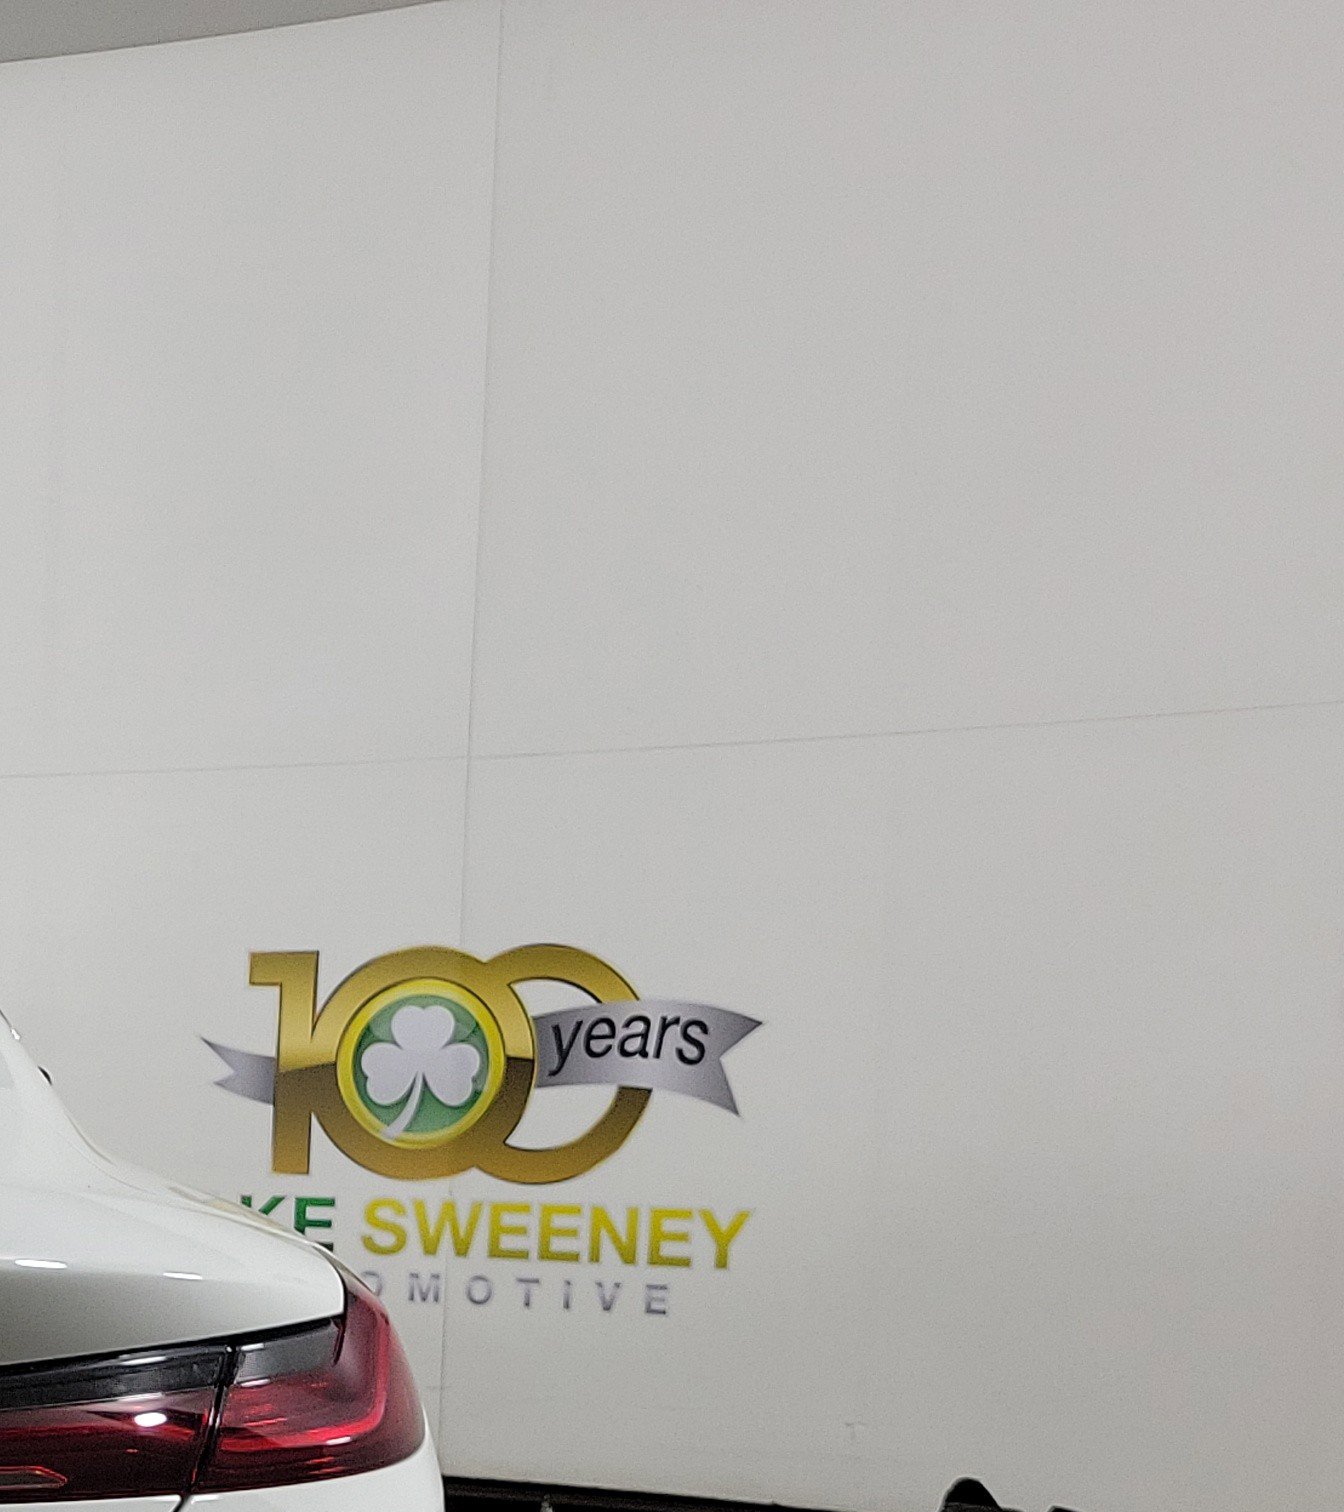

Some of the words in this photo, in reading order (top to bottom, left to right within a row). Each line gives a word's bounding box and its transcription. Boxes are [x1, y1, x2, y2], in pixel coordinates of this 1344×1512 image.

[248, 943, 653, 1185] 100
[548, 1014, 711, 1077] years
[361, 1197, 752, 1270] SWEENEY
[362, 1271, 670, 1316] OMOTIVE
